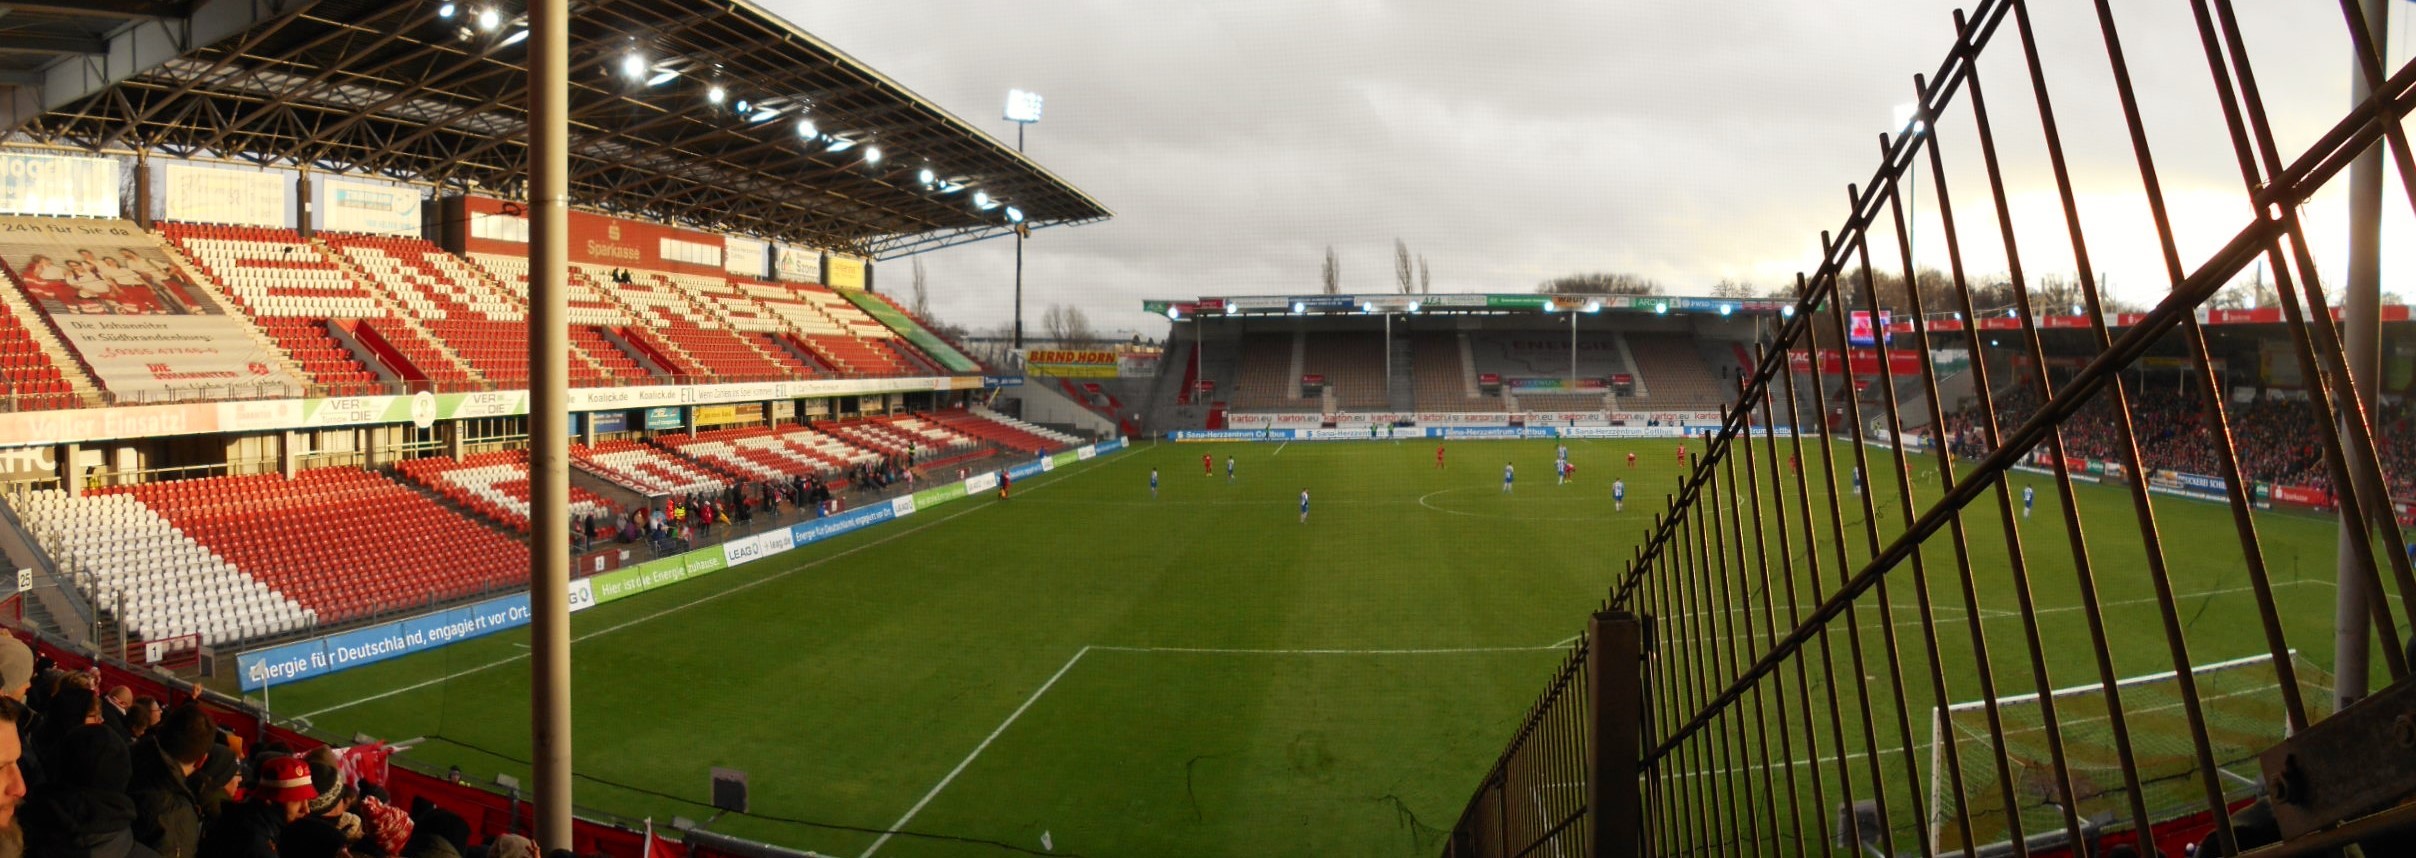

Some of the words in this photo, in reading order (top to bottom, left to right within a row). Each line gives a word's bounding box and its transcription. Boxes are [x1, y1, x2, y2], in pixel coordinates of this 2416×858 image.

[587, 241, 641, 260] Sparkasse
[1030, 351, 1076, 363] BERND
[1077, 351, 1116, 363] HORN
[331, 399, 360, 410] VER
[473, 394, 496, 403] VER
[487, 404, 505, 414] DIE
[350, 410, 372, 422] DIE
[1231, 414, 1272, 424] karton.eu
[1277, 413, 1319, 423] karton.eu
[27, 413, 95, 440] Voller
[103, 408, 187, 434] Einsatz!
[728, 547, 752, 561] LEAG
[19, 573, 31, 587] 25
[601, 580, 622, 596] Hier
[623, 577, 636, 592] ist
[653, 564, 686, 583] Energie
[311, 650, 336, 670] für
[338, 629, 427, 664] Deutschland,
[429, 615, 487, 643] engagiert
[488, 611, 507, 627] vor
[508, 605, 531, 622] Ort.
[151, 645, 158, 659] 1
